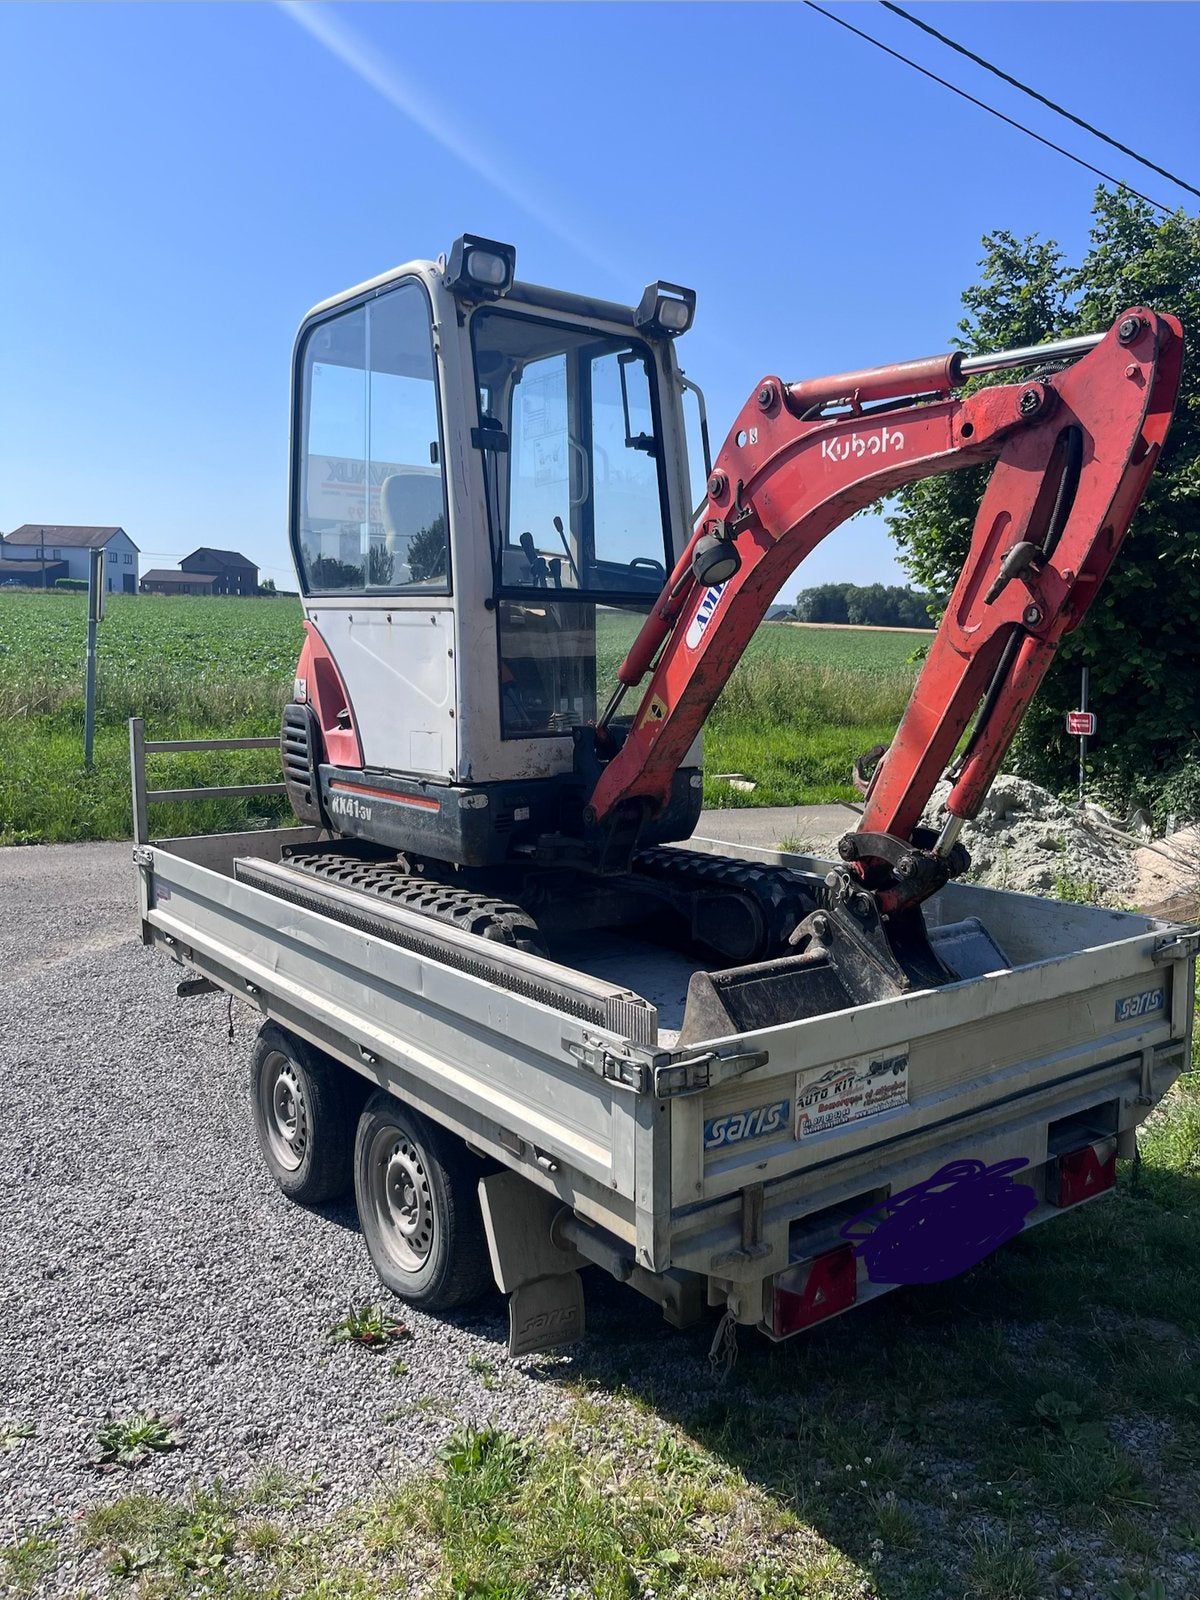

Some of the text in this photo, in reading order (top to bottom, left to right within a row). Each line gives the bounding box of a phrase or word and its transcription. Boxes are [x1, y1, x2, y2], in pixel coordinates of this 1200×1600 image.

[821, 427, 904, 461] Kubota
[1120, 989, 1161, 1019] saris
[797, 1087, 829, 1108] AUTO
[834, 1076, 856, 1094] KIT
[706, 1103, 783, 1148] saris
[520, 1305, 577, 1335] saris
